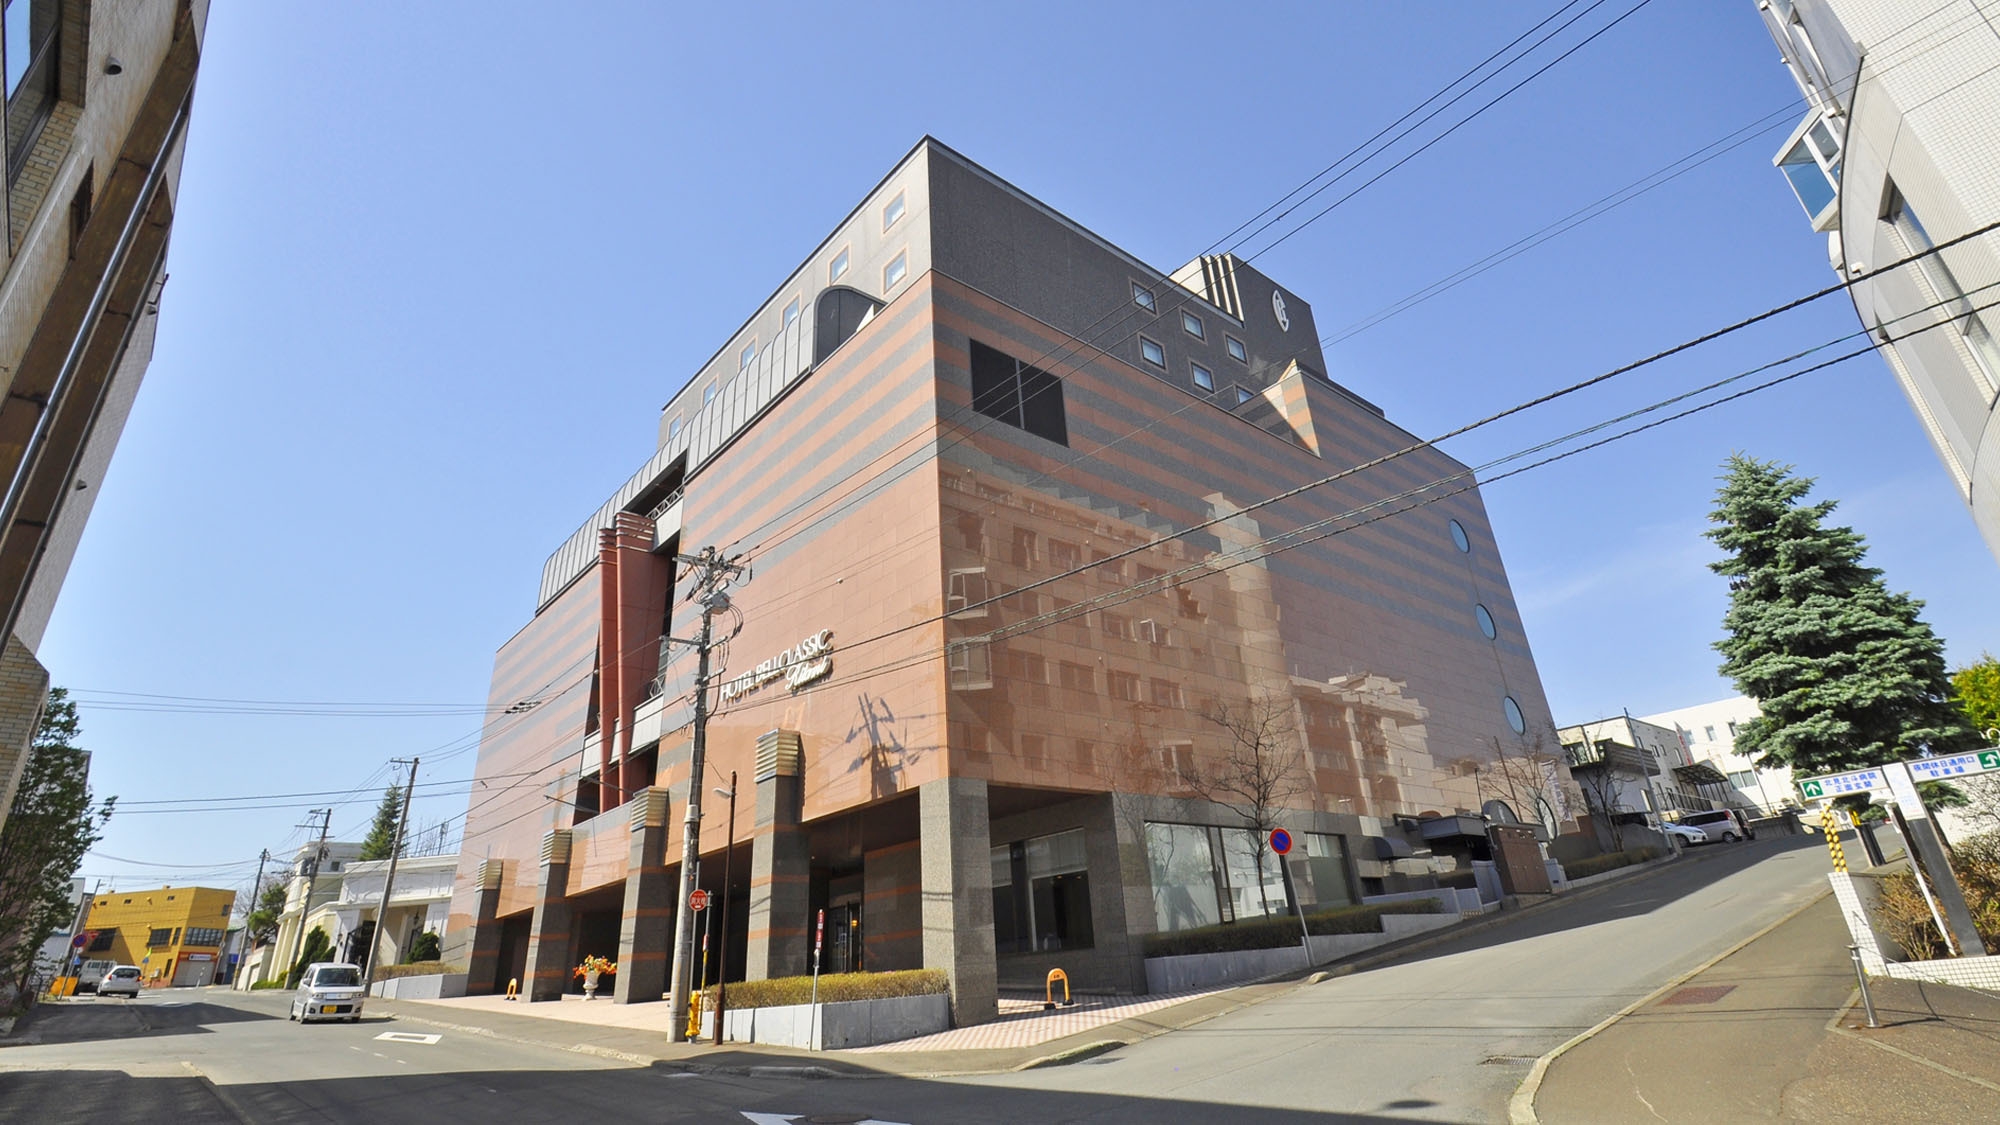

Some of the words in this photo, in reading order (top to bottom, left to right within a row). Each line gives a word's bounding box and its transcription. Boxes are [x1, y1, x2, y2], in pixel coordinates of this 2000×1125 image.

[720, 669, 754, 702] HOTEL
[779, 628, 830, 666] CLASSIC
[1930, 766, 1966, 778] 駐車場
